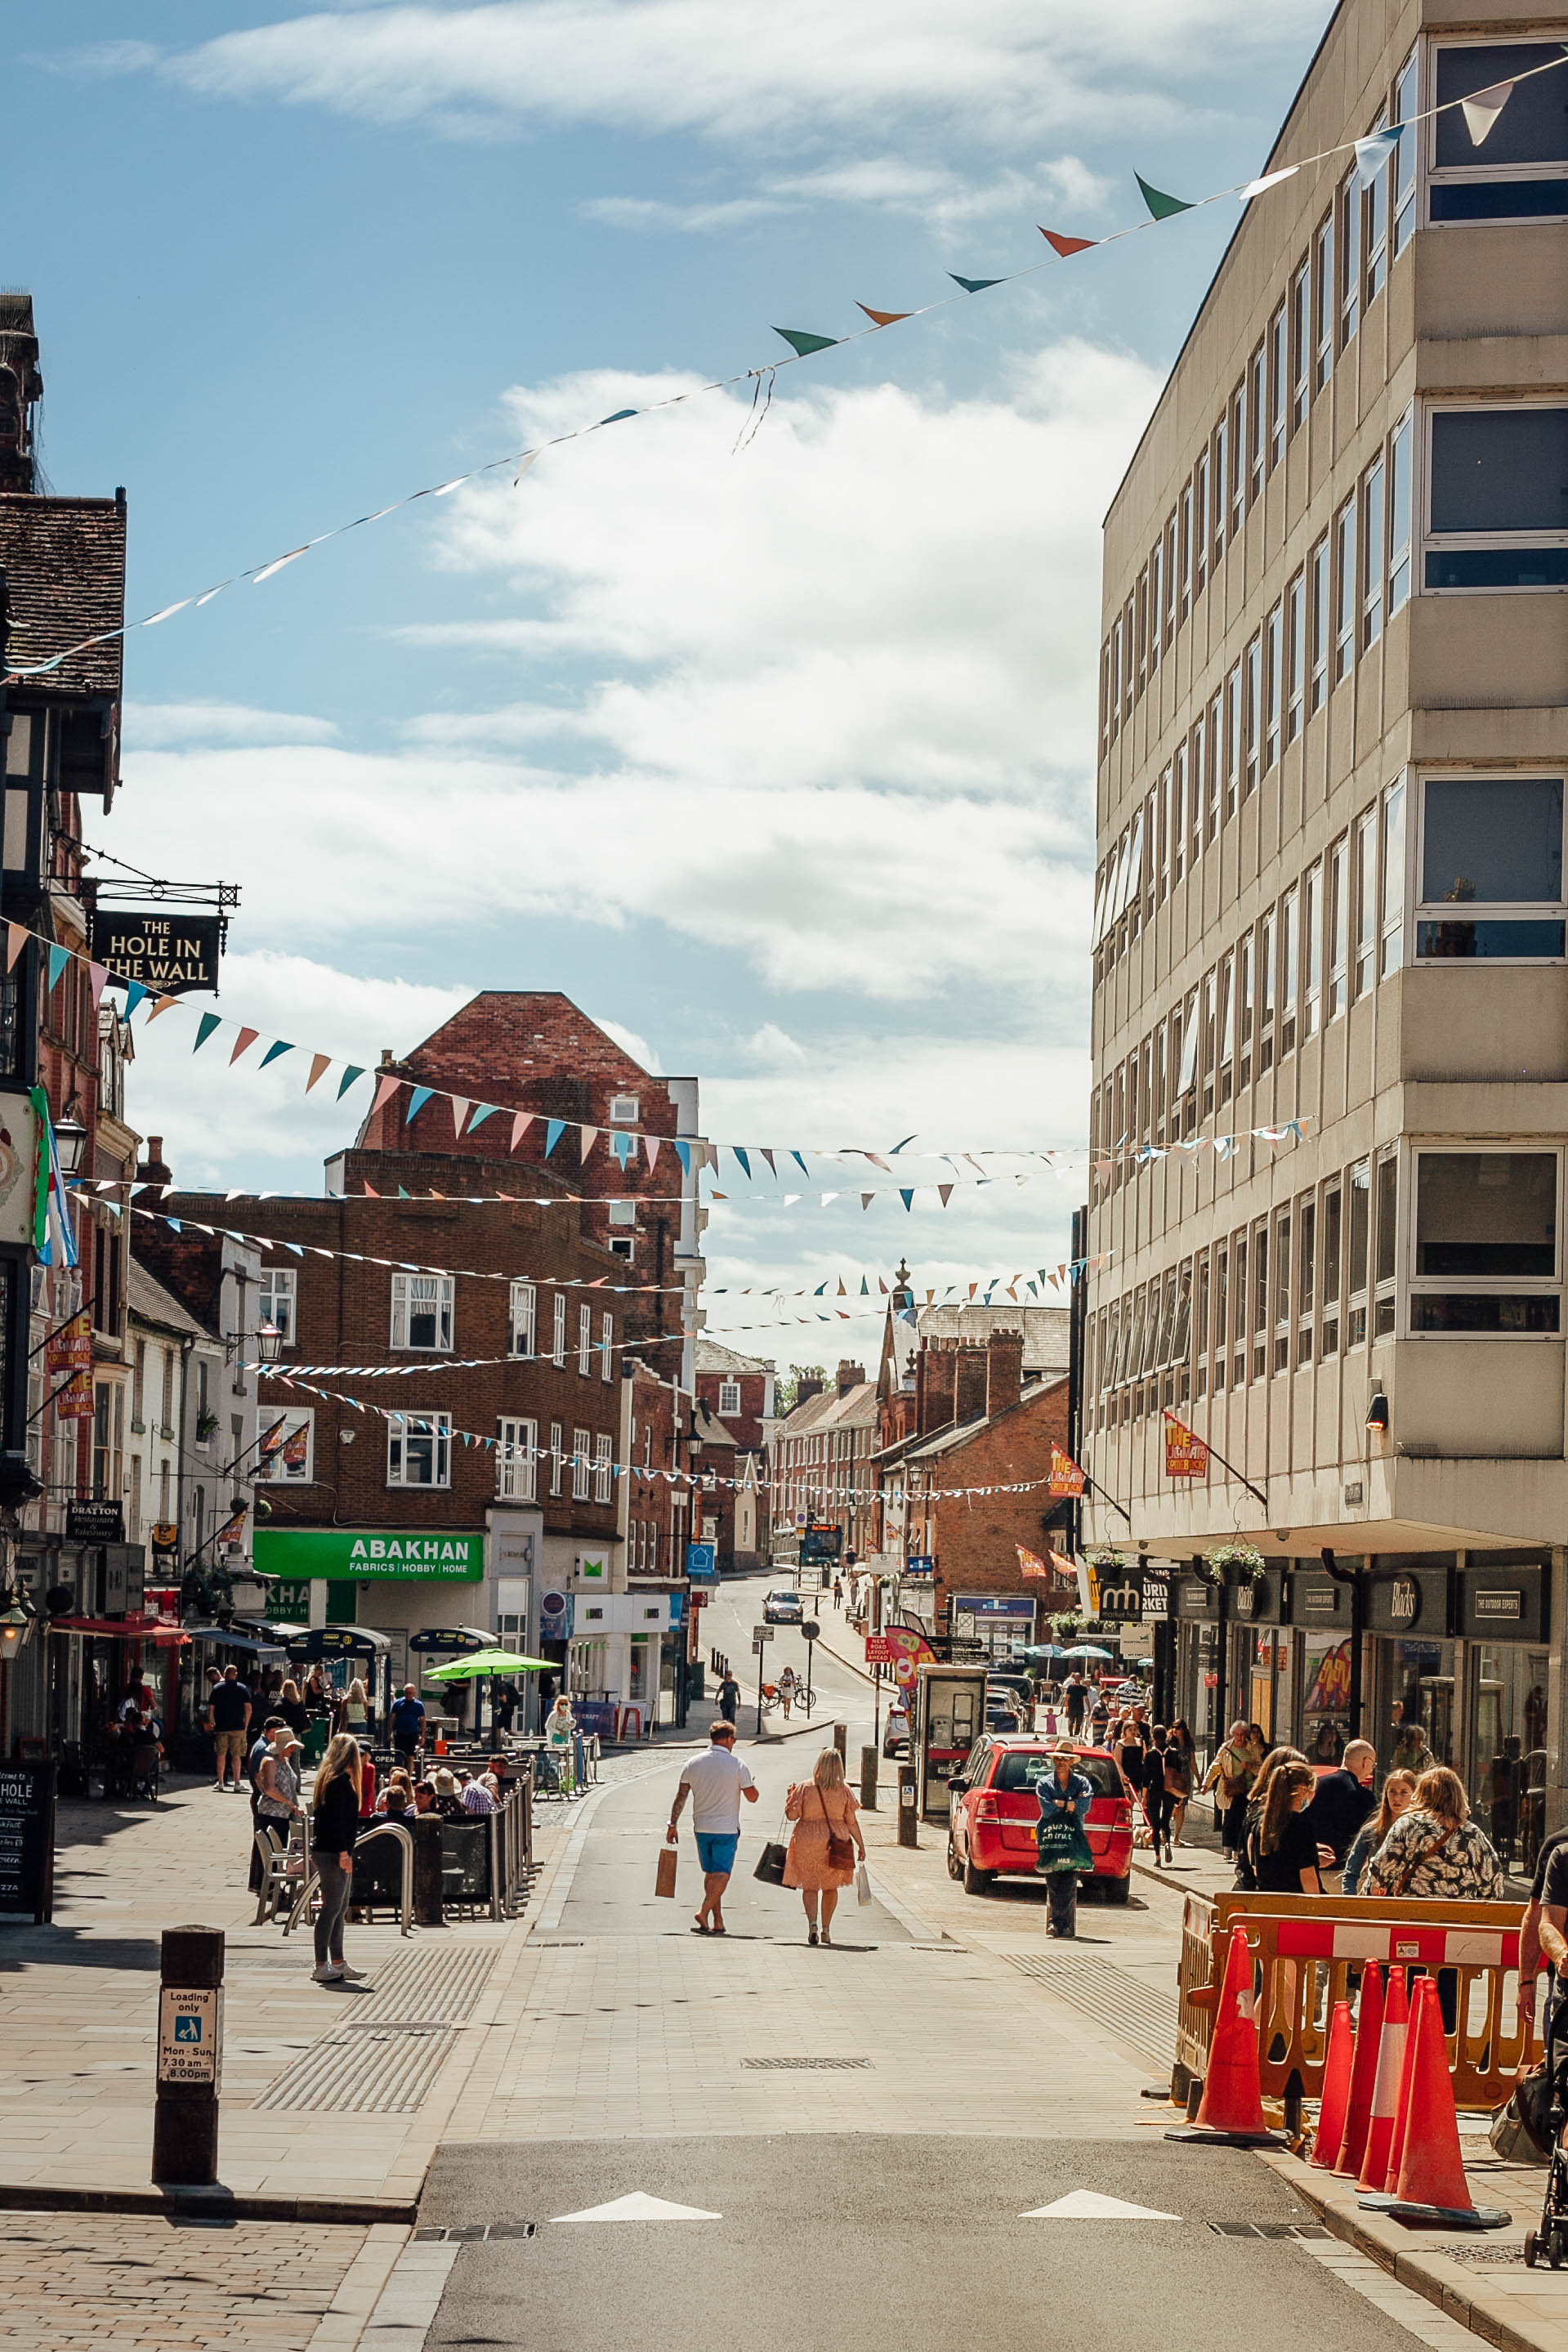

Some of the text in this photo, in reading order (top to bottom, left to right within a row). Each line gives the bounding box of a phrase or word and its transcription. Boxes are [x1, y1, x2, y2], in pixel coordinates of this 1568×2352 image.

[141, 920, 170, 934] THE
[110, 936, 201, 958] HOLE IN
[101, 958, 209, 981] THE WALL
[1165, 1422, 1191, 1448] THE
[1051, 1452, 1072, 1474] THE
[71, 1506, 118, 1516] DRAYTON
[351, 1540, 469, 1560] ABAKHAN
[349, 1563, 467, 1573] FABRICS HOBBY HOME
[1392, 1581, 1415, 1617] Blacks
[1485, 1599, 1502, 1609] OUTDOOR
[1502, 1599, 1518, 1610] EXPERTS
[1, 1784, 33, 1798] HOLE
[170, 1992, 209, 2003] Loading
[178, 2003, 199, 2013] only
[163, 2046, 185, 2055] Mon
[192, 2047, 212, 2056] Sun
[162, 2058, 185, 2067] 7.30
[170, 2068, 209, 2080] 8.00pm
